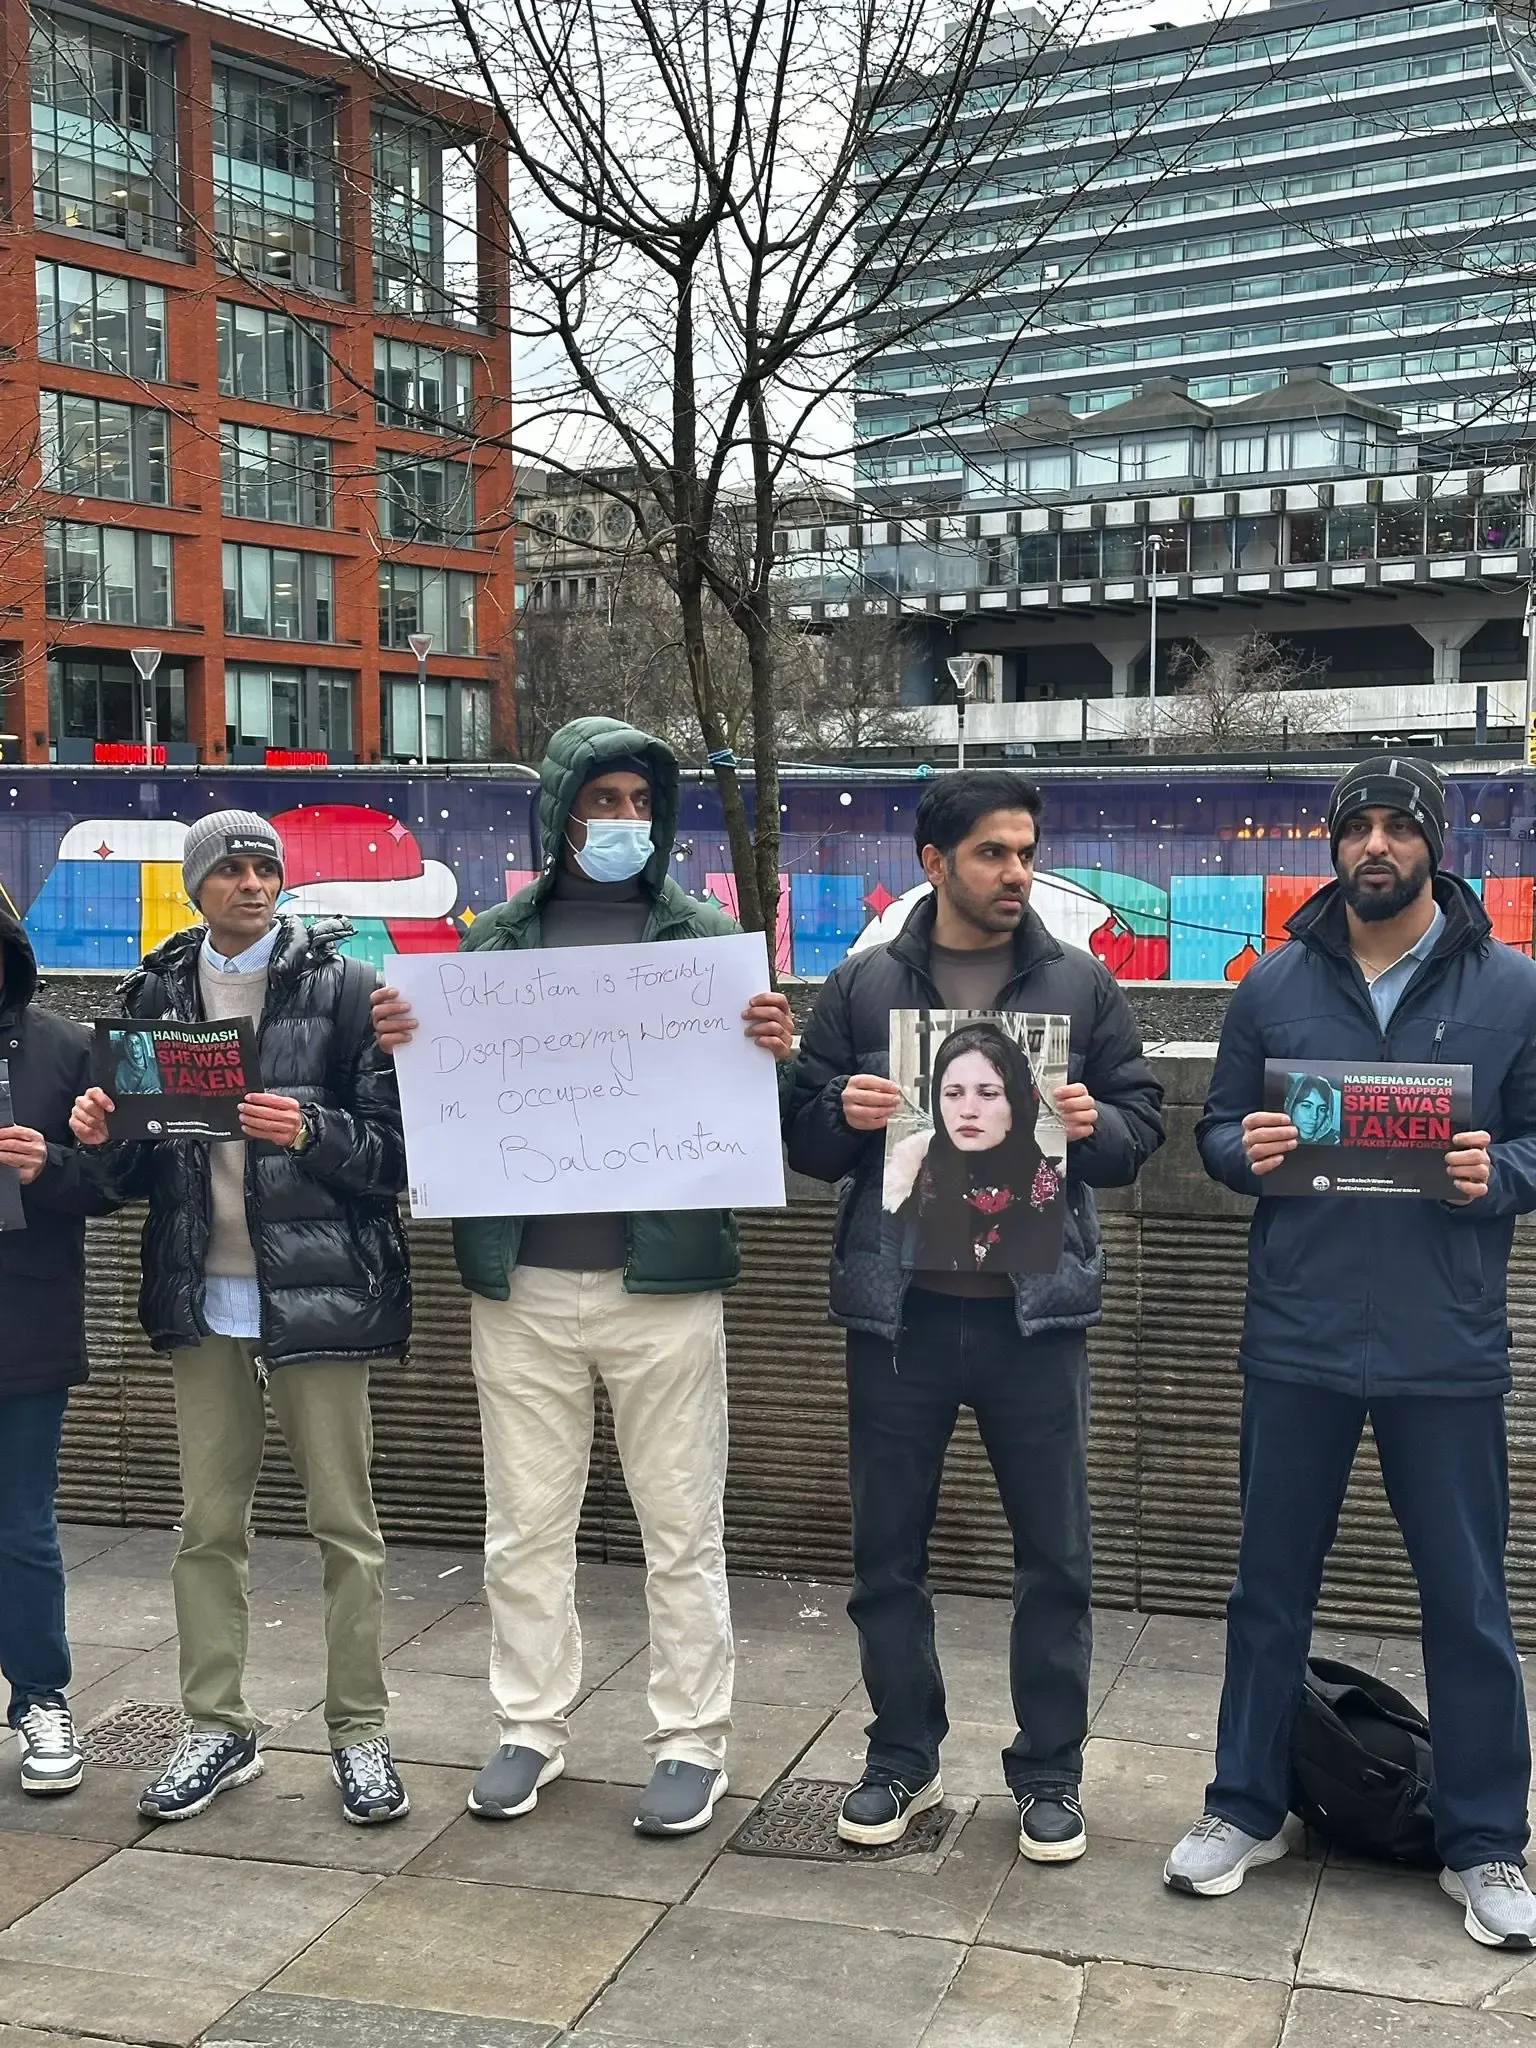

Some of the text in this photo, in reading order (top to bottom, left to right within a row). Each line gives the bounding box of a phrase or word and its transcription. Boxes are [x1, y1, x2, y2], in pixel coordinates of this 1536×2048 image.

[438, 957, 716, 1015] Pakistan is Forcibly
[153, 1029, 239, 1044] HANI DILWASH
[431, 1014, 731, 1082] Disappearing Women
[158, 1049, 241, 1068] SHE WAS
[162, 1067, 246, 1090] TAKEN
[1343, 1075, 1453, 1087] NASREENA BALOCH
[1344, 1085, 1453, 1096] DID NOT DISAPPEAR
[440, 1103, 467, 1123] in
[1343, 1095, 1451, 1114] SHE WAS
[1344, 1115, 1451, 1140] TAKEN
